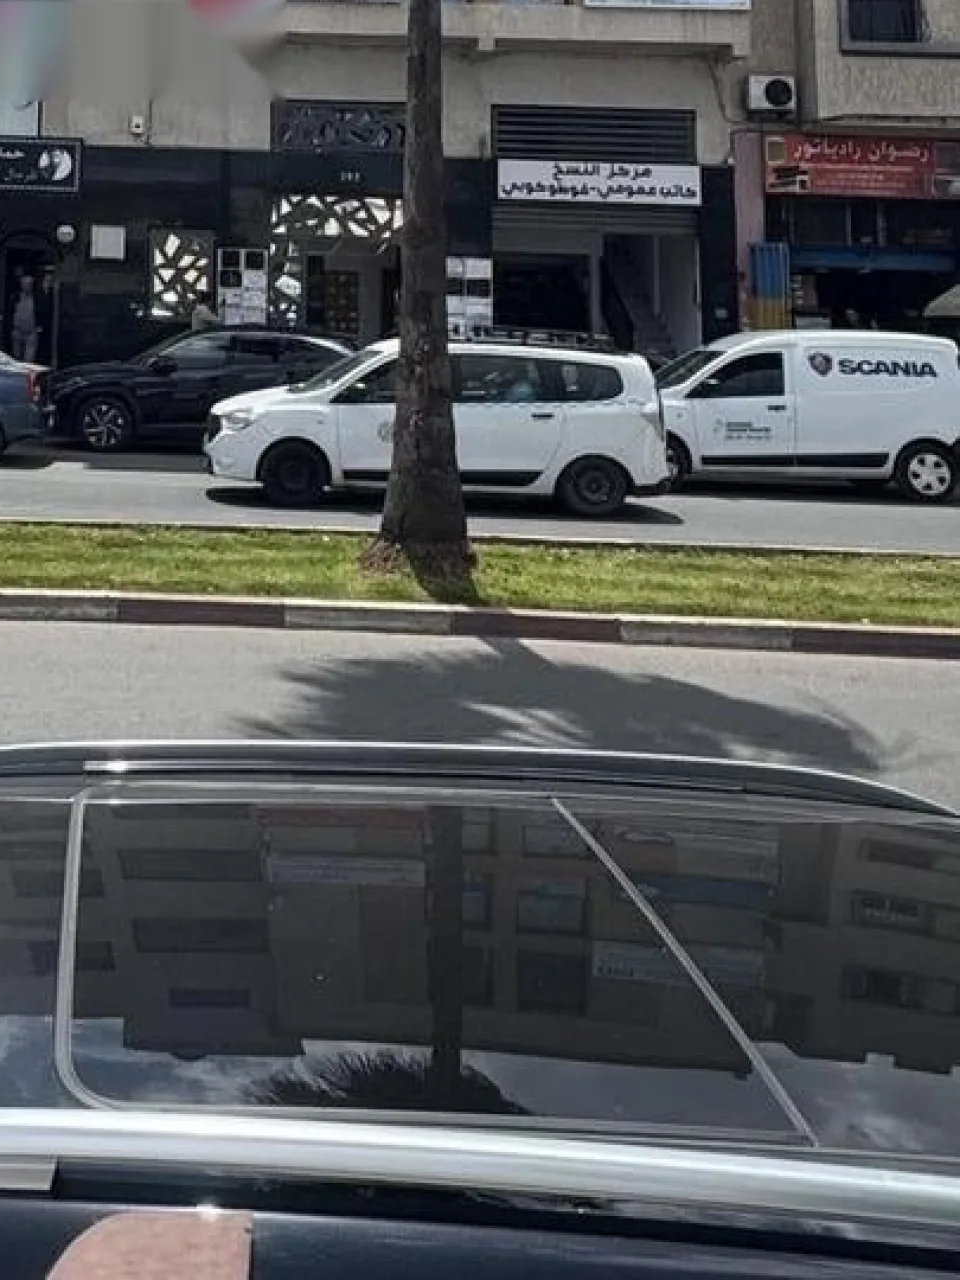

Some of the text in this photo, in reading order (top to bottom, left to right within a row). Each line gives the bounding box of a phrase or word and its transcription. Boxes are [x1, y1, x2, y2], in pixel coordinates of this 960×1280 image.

[551, 161, 653, 181] مركز النسخ
[659, 183, 698, 200] كاتب
[838, 359, 939, 378] SCANIA
